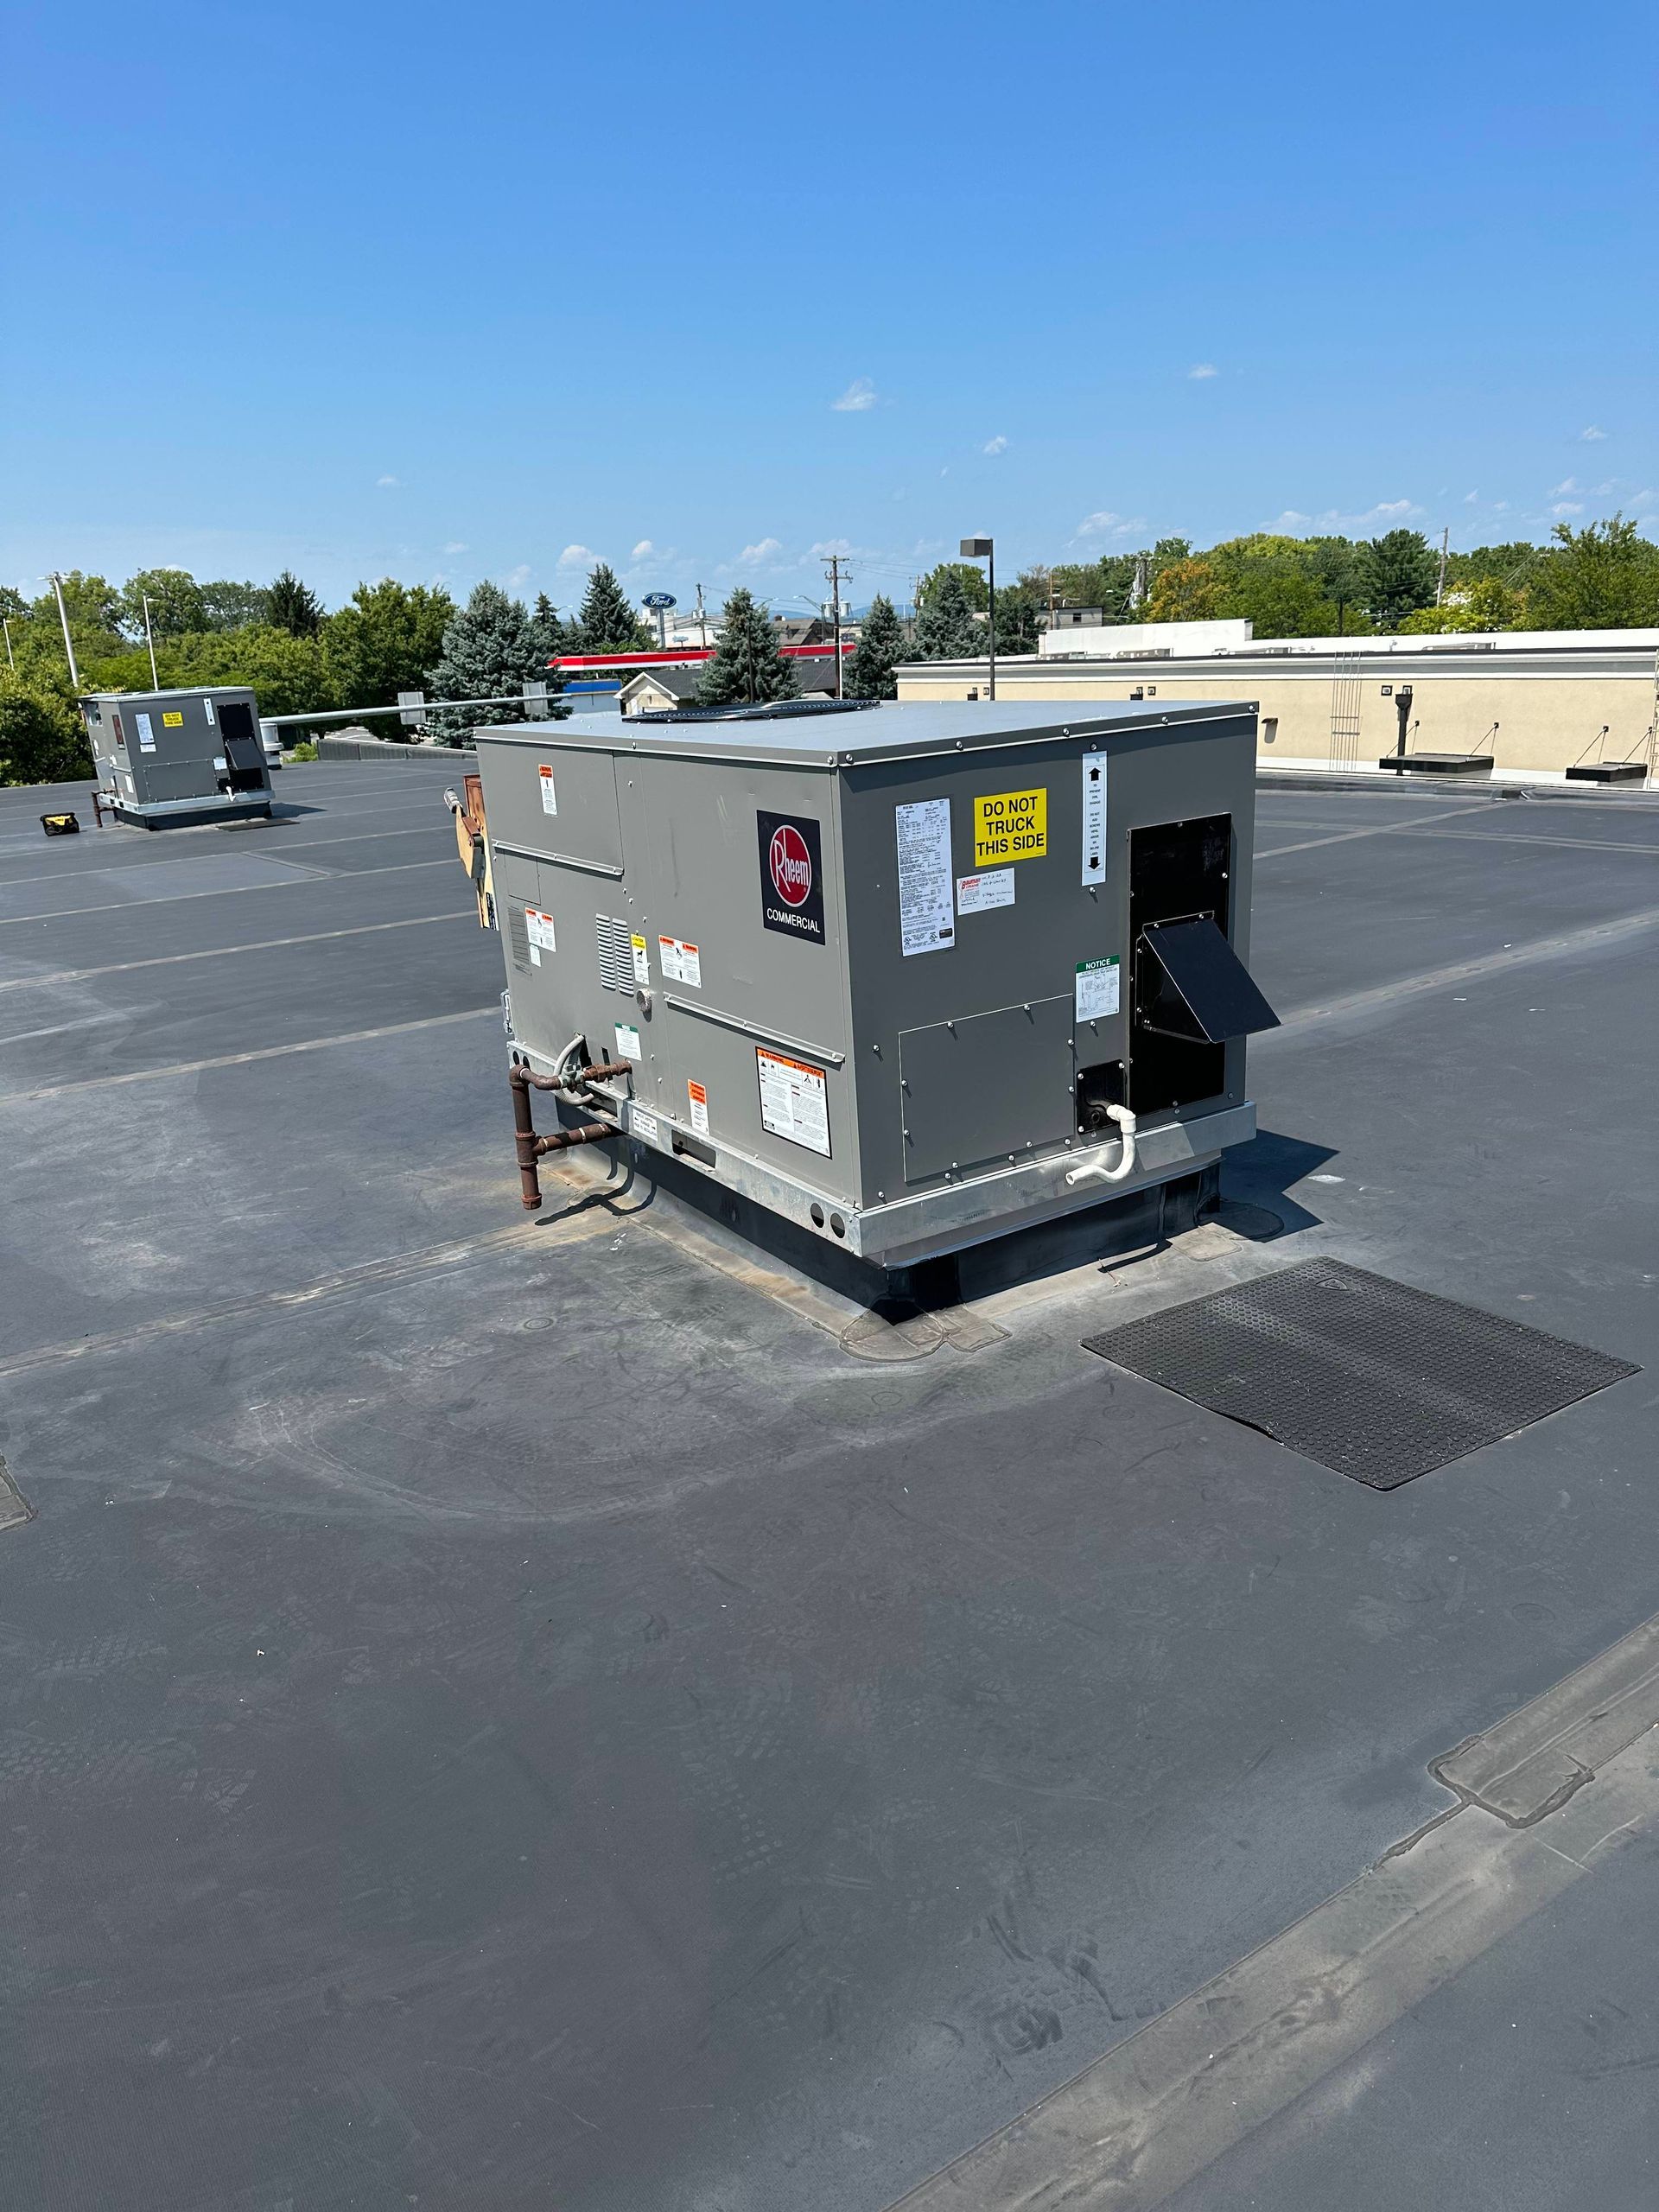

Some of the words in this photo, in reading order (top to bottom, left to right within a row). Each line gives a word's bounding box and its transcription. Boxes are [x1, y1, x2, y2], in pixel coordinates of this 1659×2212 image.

[651, 595, 671, 606] Ford
[983, 801, 1005, 817] DO
[1008, 796, 1039, 813] NOT
[986, 816, 1035, 836] TRUCK
[976, 838, 1009, 856] THIS
[1013, 833, 1045, 851] SIDE
[774, 829, 809, 892] Rheem
[766, 907, 821, 933] COMMERCIAL
[1085, 958, 1110, 969] NOTICE
